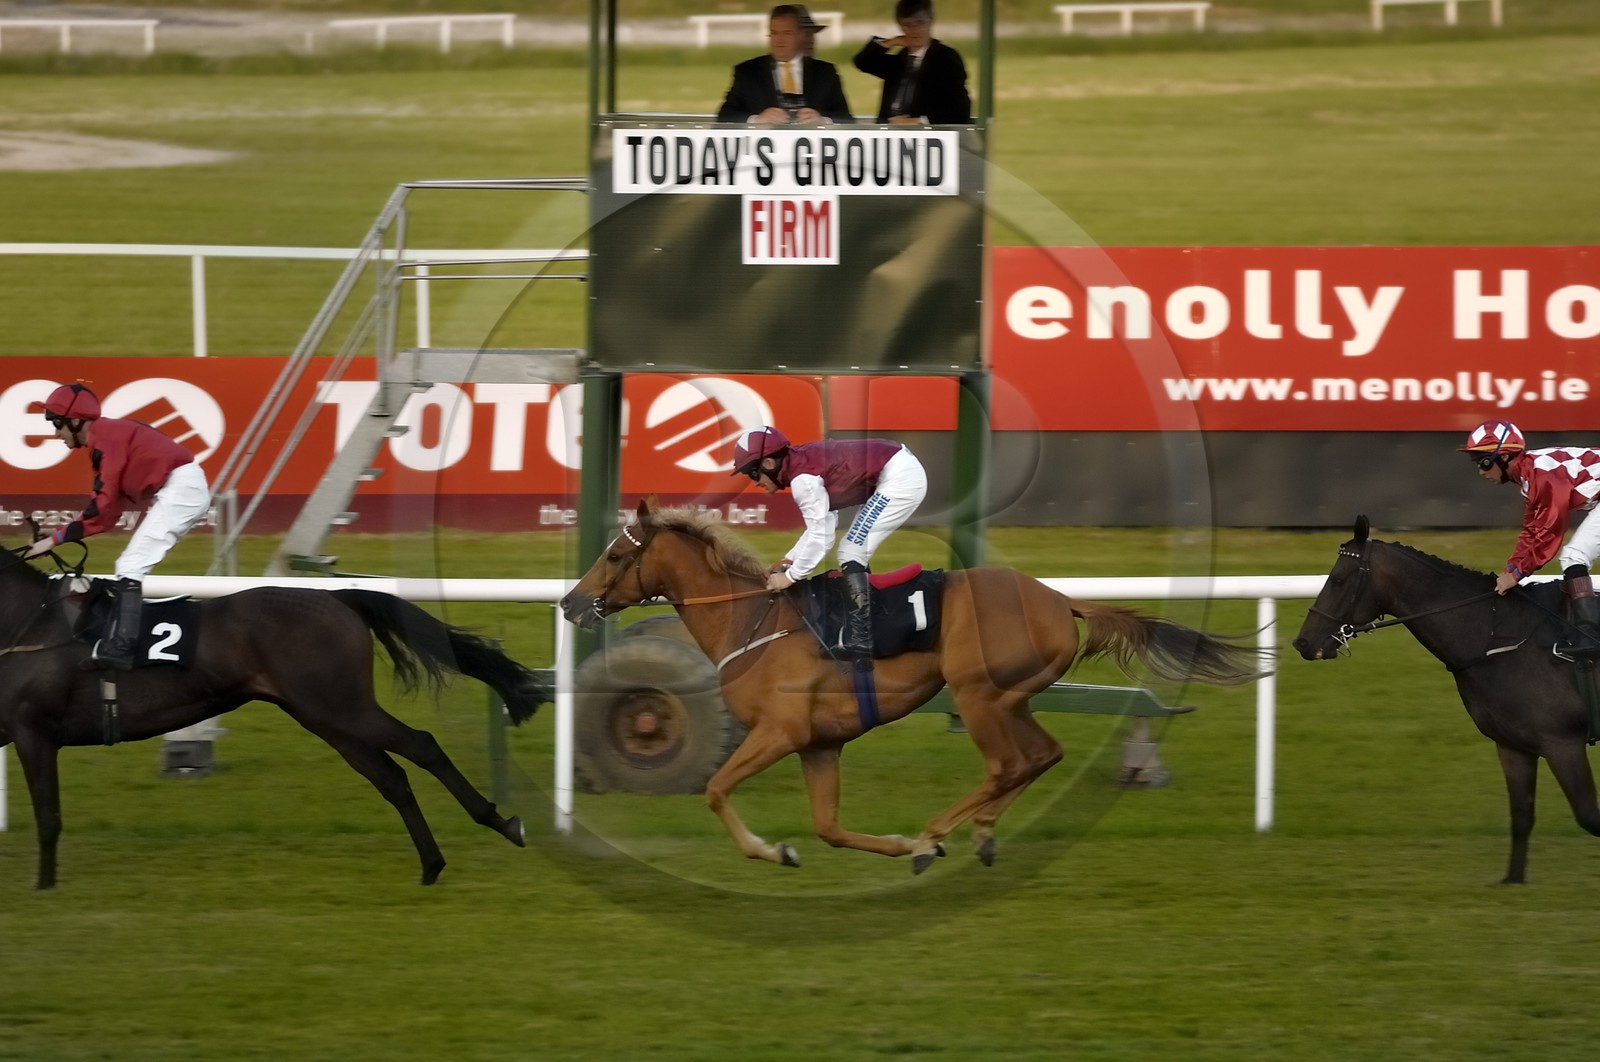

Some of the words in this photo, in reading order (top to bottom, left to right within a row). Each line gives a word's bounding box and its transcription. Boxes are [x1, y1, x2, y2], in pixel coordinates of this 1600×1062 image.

[625, 136, 774, 187] TODAY'S
[795, 137, 943, 187] GROUND
[751, 200, 831, 258] FIRM
[1454, 269, 1600, 339] Ho
[1162, 370, 1590, 408] www.menolly.ie
[539, 504, 578, 525] the
[728, 503, 769, 524] bet
[854, 494, 891, 546] SILVERWARE
[908, 591, 927, 631] 1
[148, 622, 182, 661] 2
